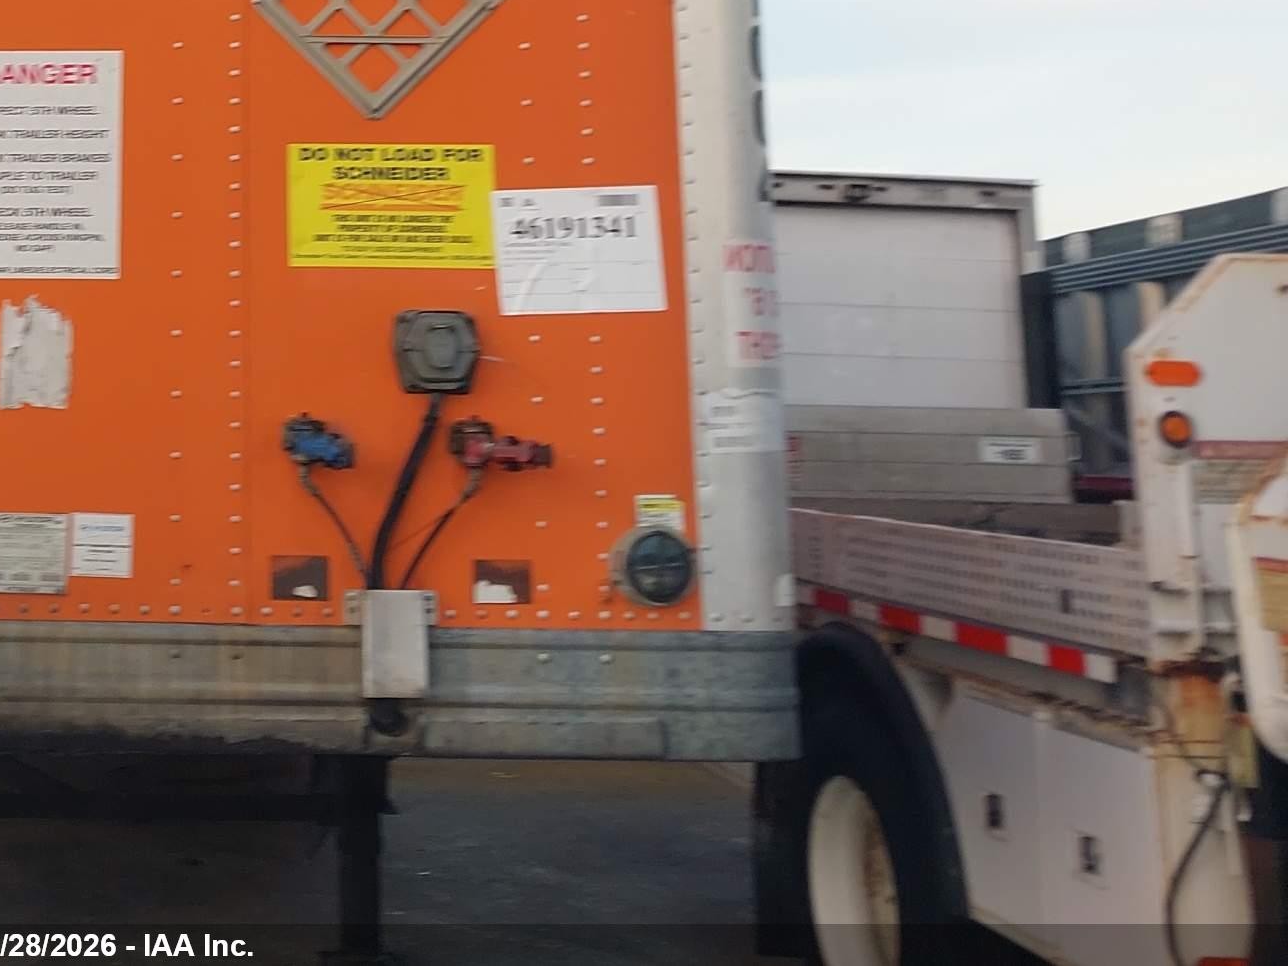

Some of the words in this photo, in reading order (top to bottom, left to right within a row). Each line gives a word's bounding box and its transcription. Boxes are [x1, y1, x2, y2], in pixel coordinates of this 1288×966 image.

[55, 106, 101, 116] WHEEL
[9, 129, 60, 139] TRAILER
[62, 129, 110, 139] HEIGHT
[8, 153, 59, 163] TRAILER
[60, 153, 112, 163] BRAKES
[380, 148, 434, 162] LOAD
[46, 171, 98, 181] TRAILER
[332, 166, 450, 181] SCHNEIDER
[50, 207, 95, 217] WHEEL
[509, 215, 637, 240] 46191341
